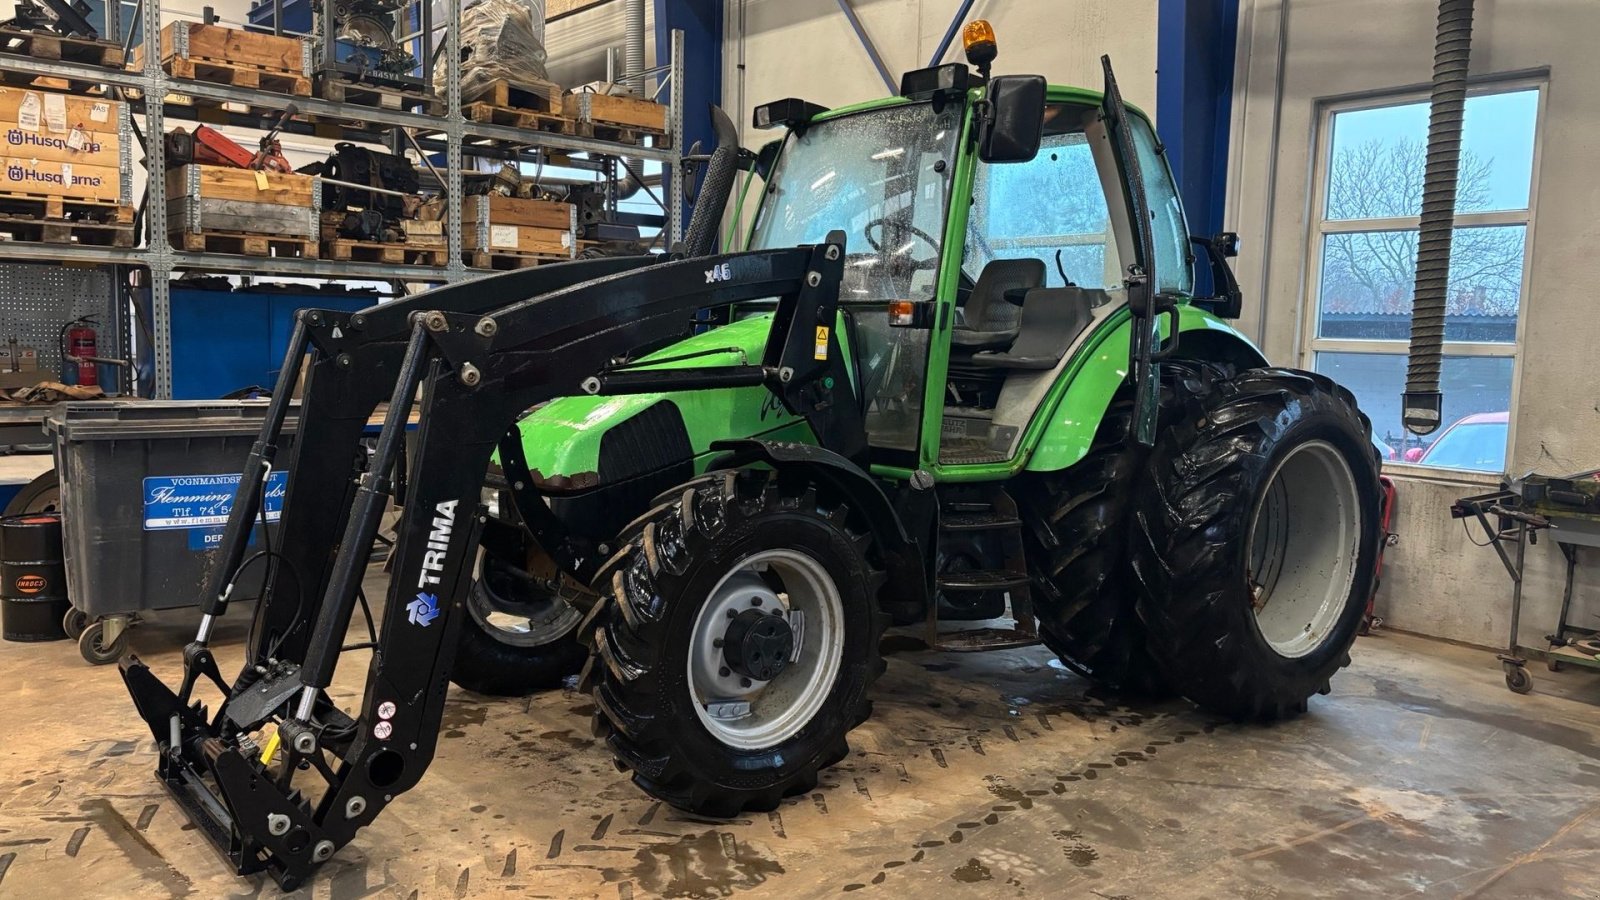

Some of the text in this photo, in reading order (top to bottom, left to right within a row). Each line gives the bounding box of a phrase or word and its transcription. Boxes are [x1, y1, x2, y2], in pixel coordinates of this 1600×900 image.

[24, 169, 101, 187] Husqarna
[144, 486, 232, 508] Flemming
[172, 507, 194, 517] Tlf.
[199, 506, 215, 516] 74
[418, 499, 459, 588] TRIMA
